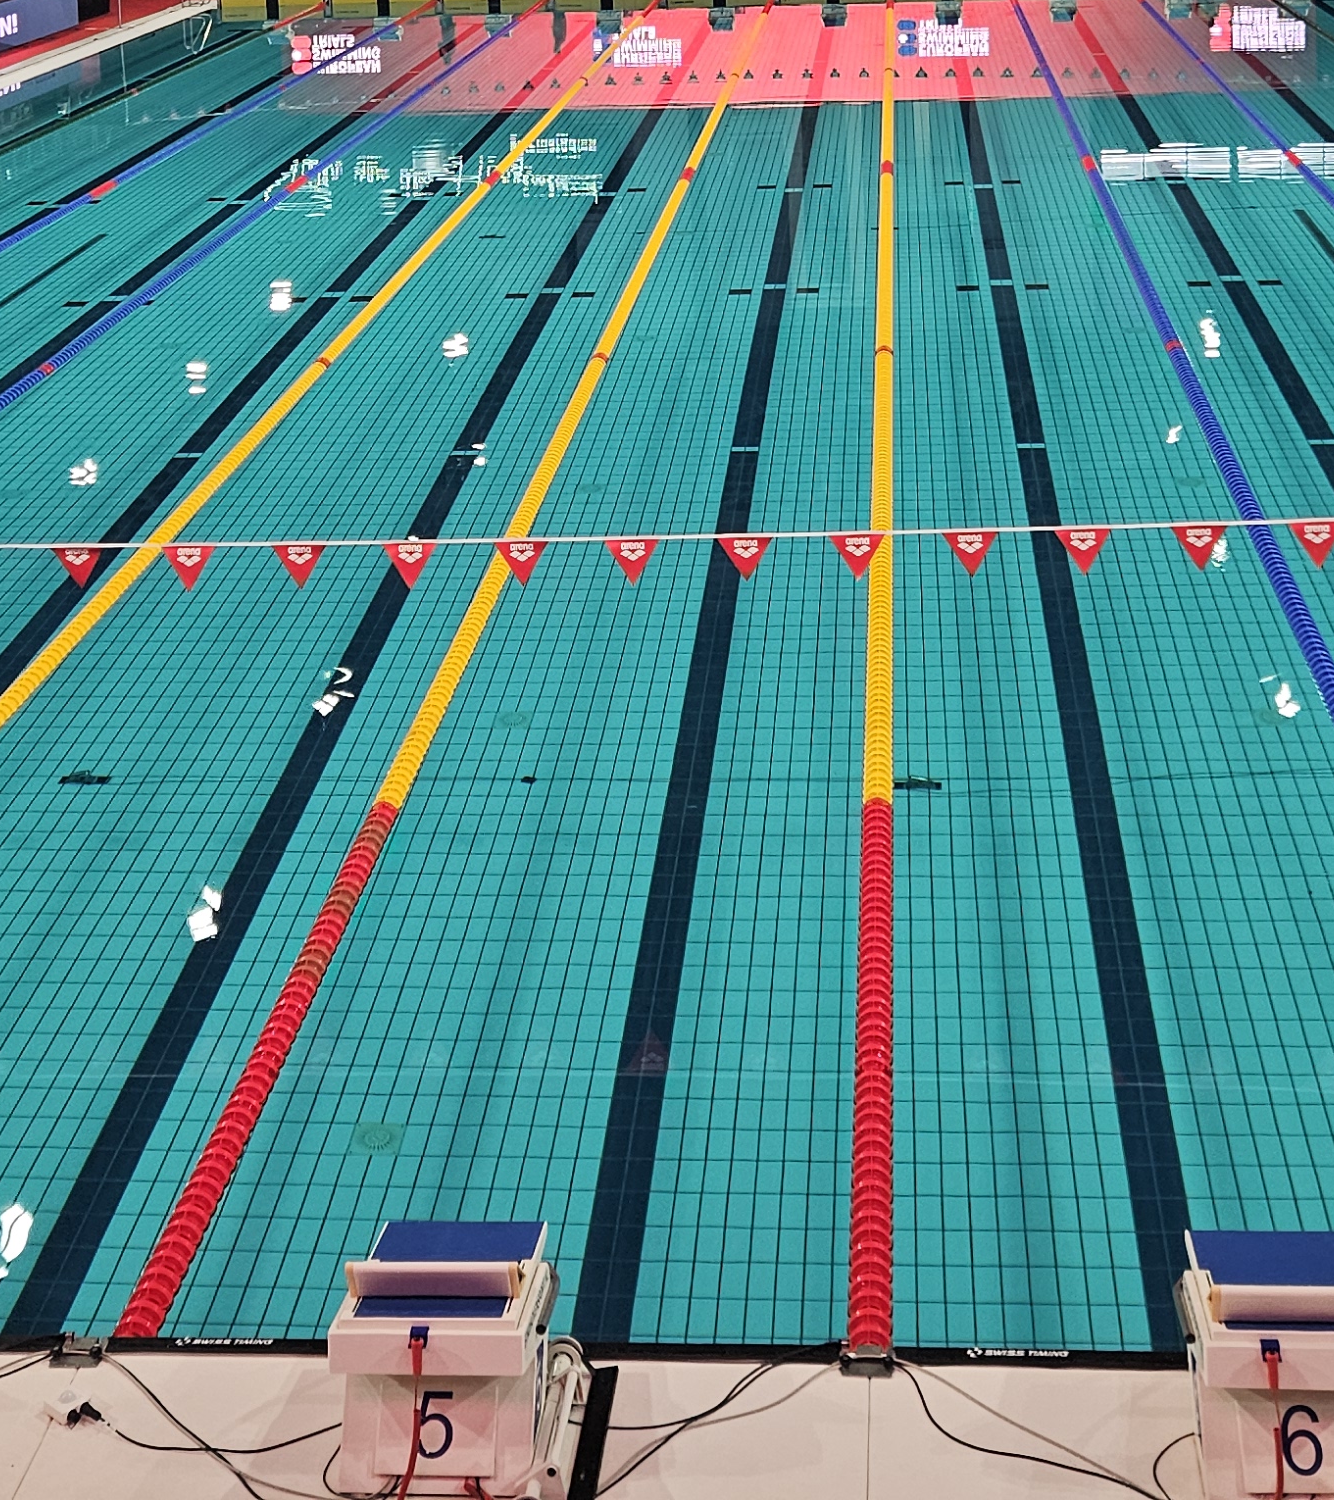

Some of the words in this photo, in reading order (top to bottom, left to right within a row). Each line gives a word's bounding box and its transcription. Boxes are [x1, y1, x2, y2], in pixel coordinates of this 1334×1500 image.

[1186, 528, 1212, 537] arena
[1304, 524, 1331, 534] arena
[957, 533, 982, 543] arena
[1071, 531, 1096, 540] arena
[733, 539, 758, 548] arena
[845, 536, 870, 546] arena
[288, 545, 312, 554] arena
[398, 544, 423, 553] arena
[509, 543, 534, 552] arena
[620, 541, 645, 551] arena
[177, 547, 201, 556] arena
[984, 1349, 1025, 1357] SWISS
[418, 1391, 453, 1459] 5
[1281, 1404, 1323, 1476] 6
